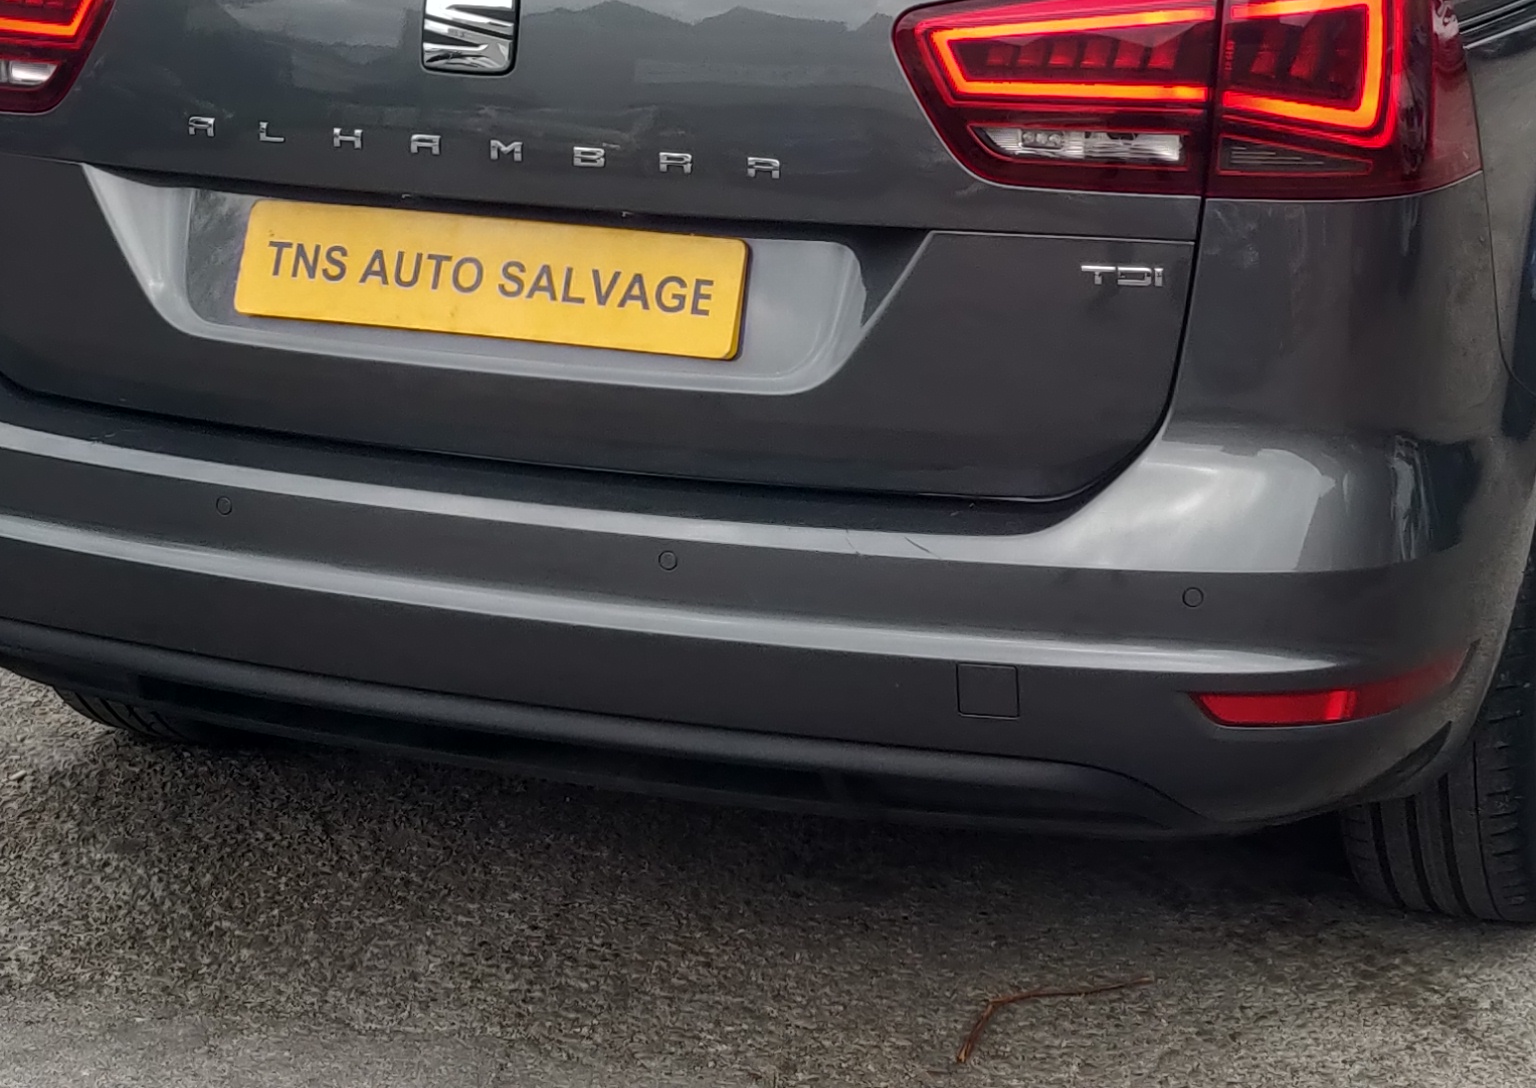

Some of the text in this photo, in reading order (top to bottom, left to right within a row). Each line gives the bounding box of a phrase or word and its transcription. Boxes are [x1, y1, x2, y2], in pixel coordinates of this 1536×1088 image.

[187, 115, 781, 180] ALHAMBRA
[268, 240, 715, 317] TNS AUTO SALVAGE
[1080, 264, 1164, 287] TDI
